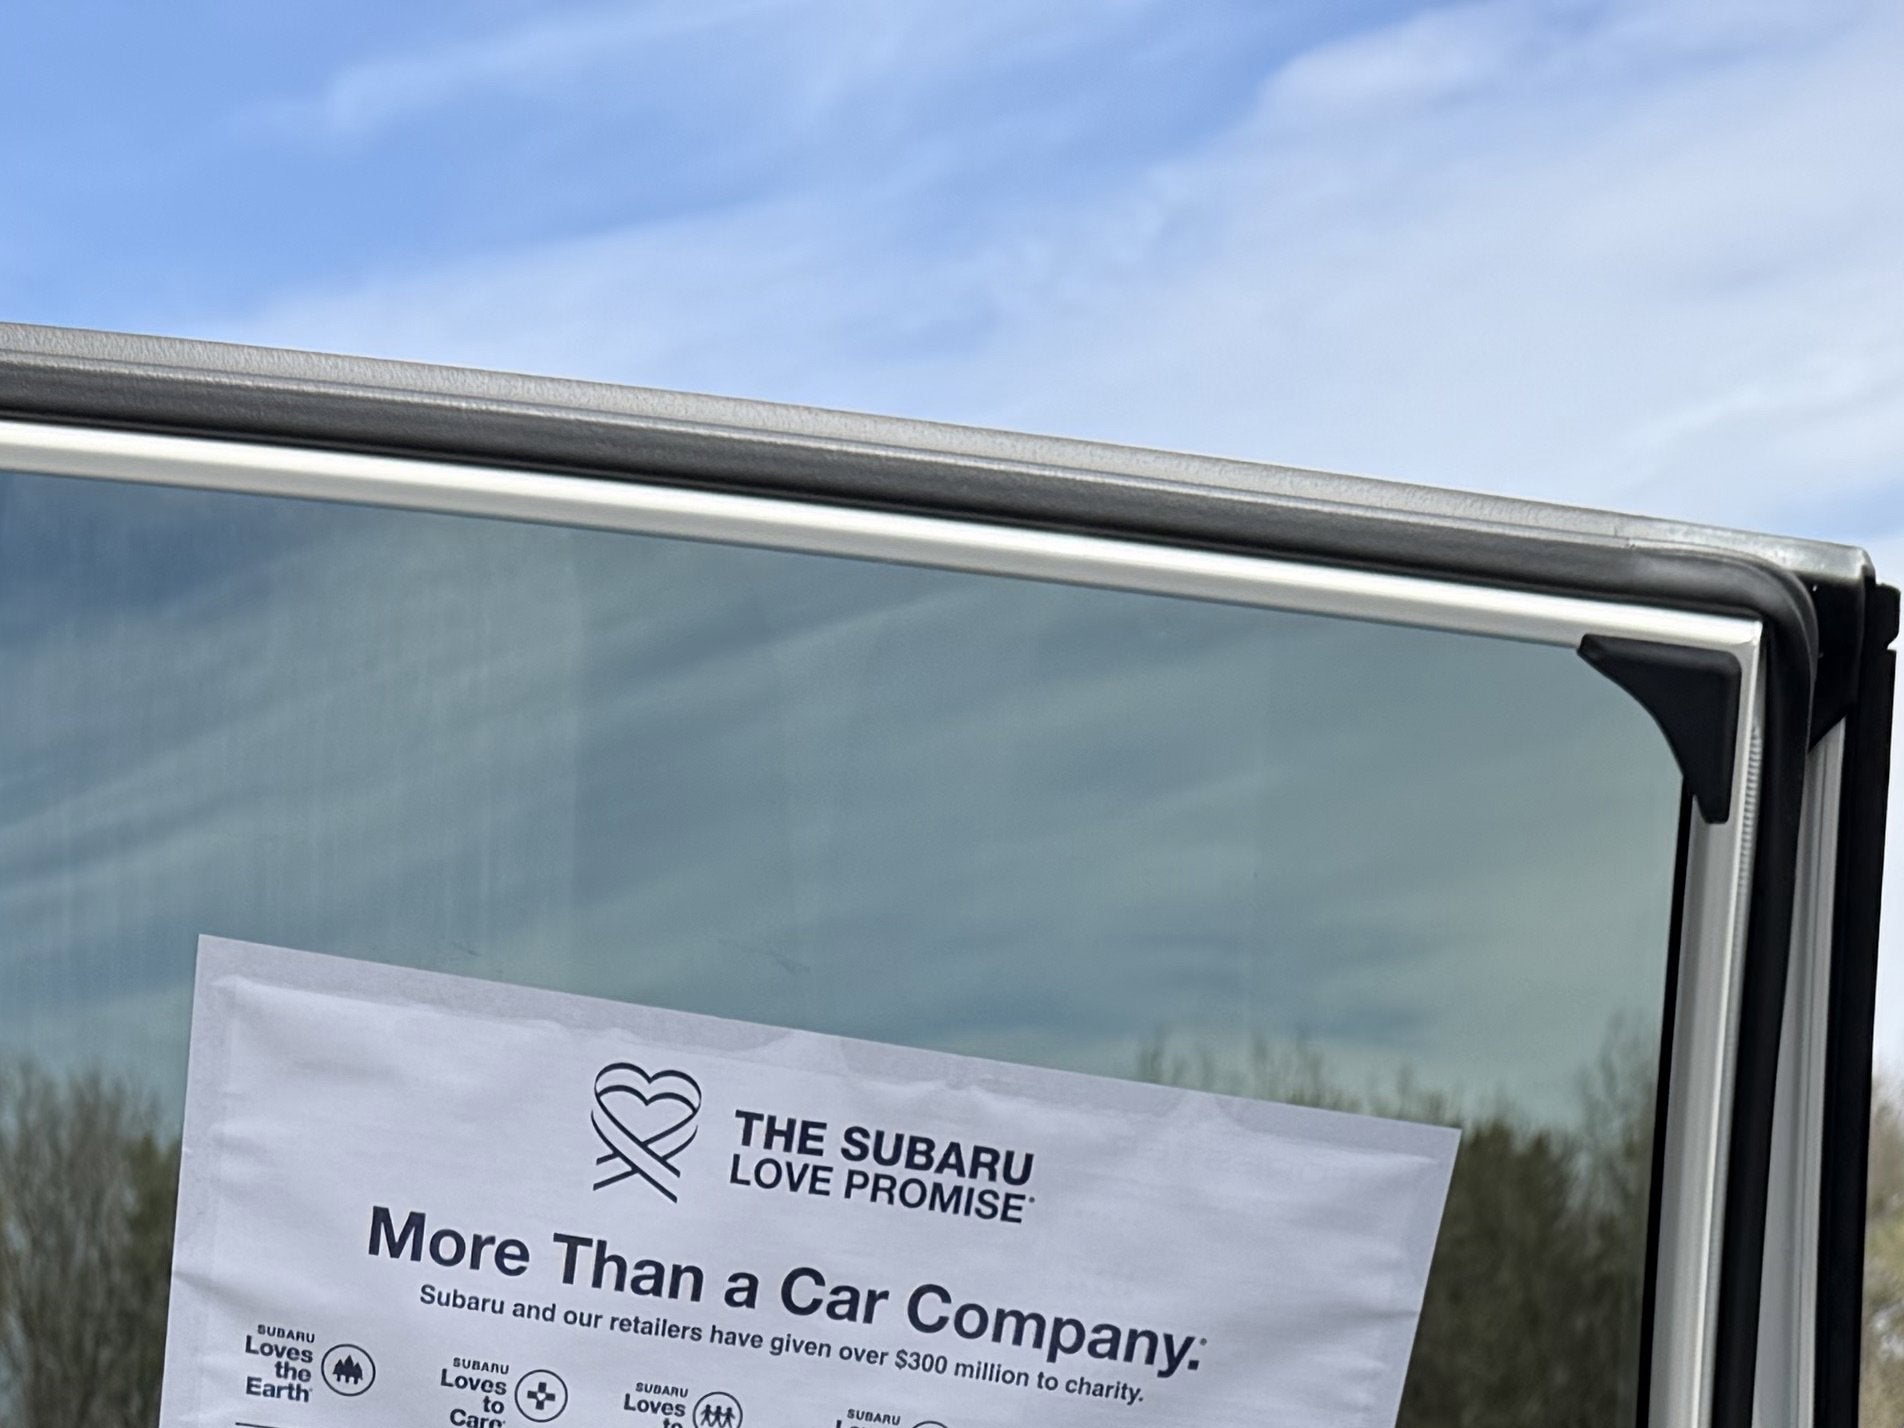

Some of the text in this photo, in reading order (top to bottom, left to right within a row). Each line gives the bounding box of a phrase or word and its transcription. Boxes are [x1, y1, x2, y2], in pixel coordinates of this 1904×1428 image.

[735, 1109, 1034, 1186] THE SUBARU
[730, 1153, 1026, 1224] LOVE PROMISE
[368, 1205, 530, 1276] More
[553, 1232, 704, 1302] Than
[724, 1272, 759, 1309] a
[781, 1267, 890, 1324] Car
[257, 1324, 315, 1344] SUBARU
[420, 1284, 1144, 1406] Subaru and our retailers have given over $300 million to charity.
[245, 1336, 314, 1364] Loves
[274, 1362, 312, 1383] the
[453, 1357, 509, 1375] SUBARU
[245, 1378, 312, 1403] Earth
[440, 1368, 507, 1396] Loves
[635, 1382, 689, 1398] SUBARU
[482, 1396, 505, 1415] to
[623, 1393, 686, 1418] Loves
[846, 1408, 901, 1426] SUBARU
